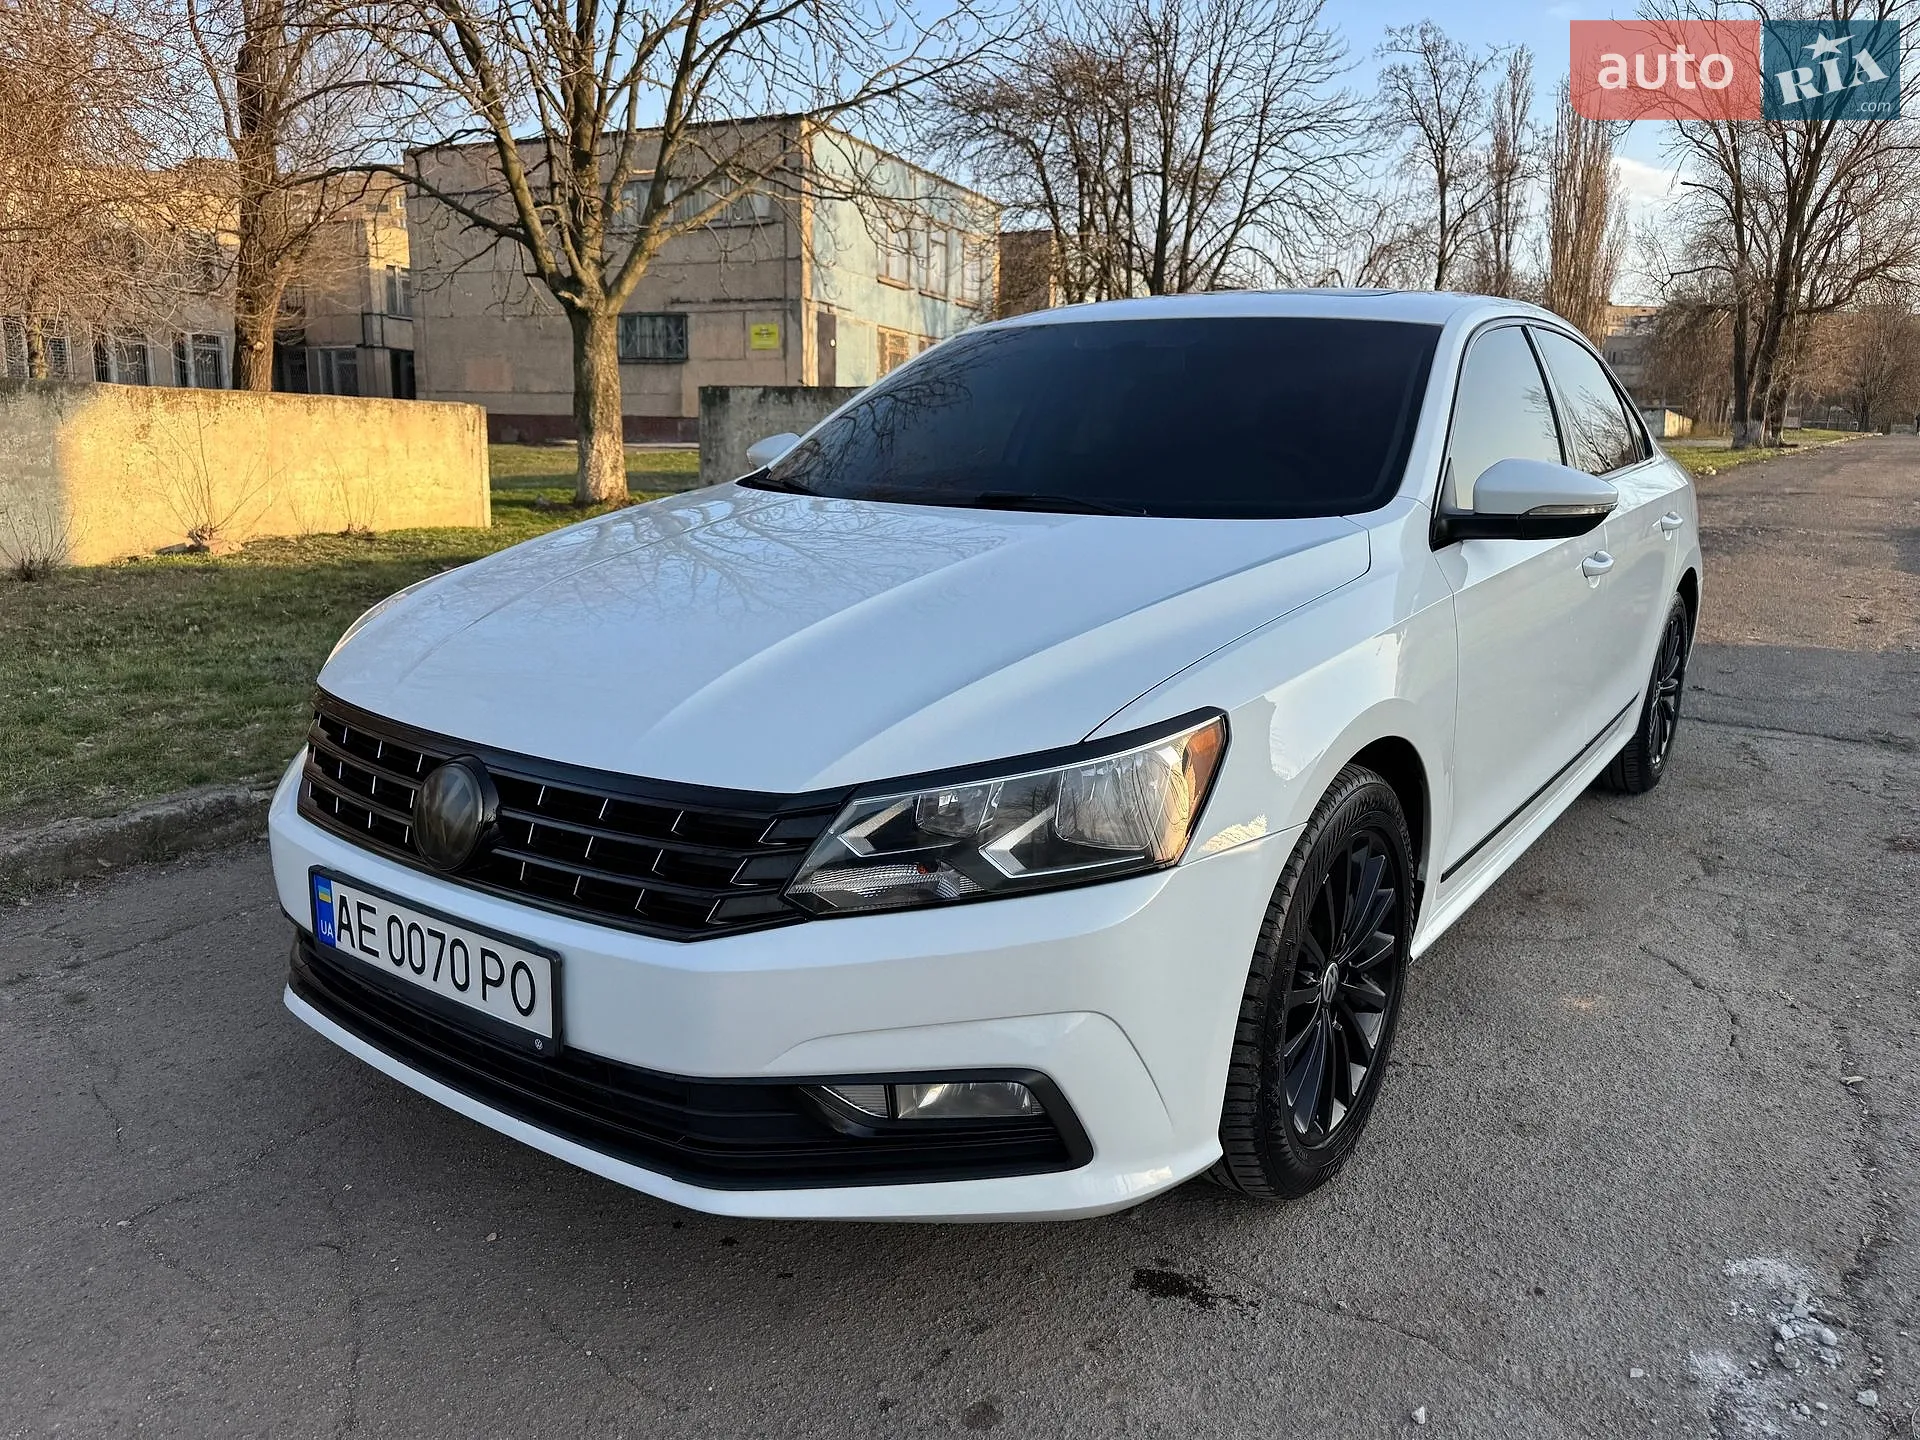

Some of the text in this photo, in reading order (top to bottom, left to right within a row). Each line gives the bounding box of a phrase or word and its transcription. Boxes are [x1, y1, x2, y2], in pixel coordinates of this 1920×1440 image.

[320, 919, 334, 939] UA
[337, 894, 536, 1017] AE 0070 PO
